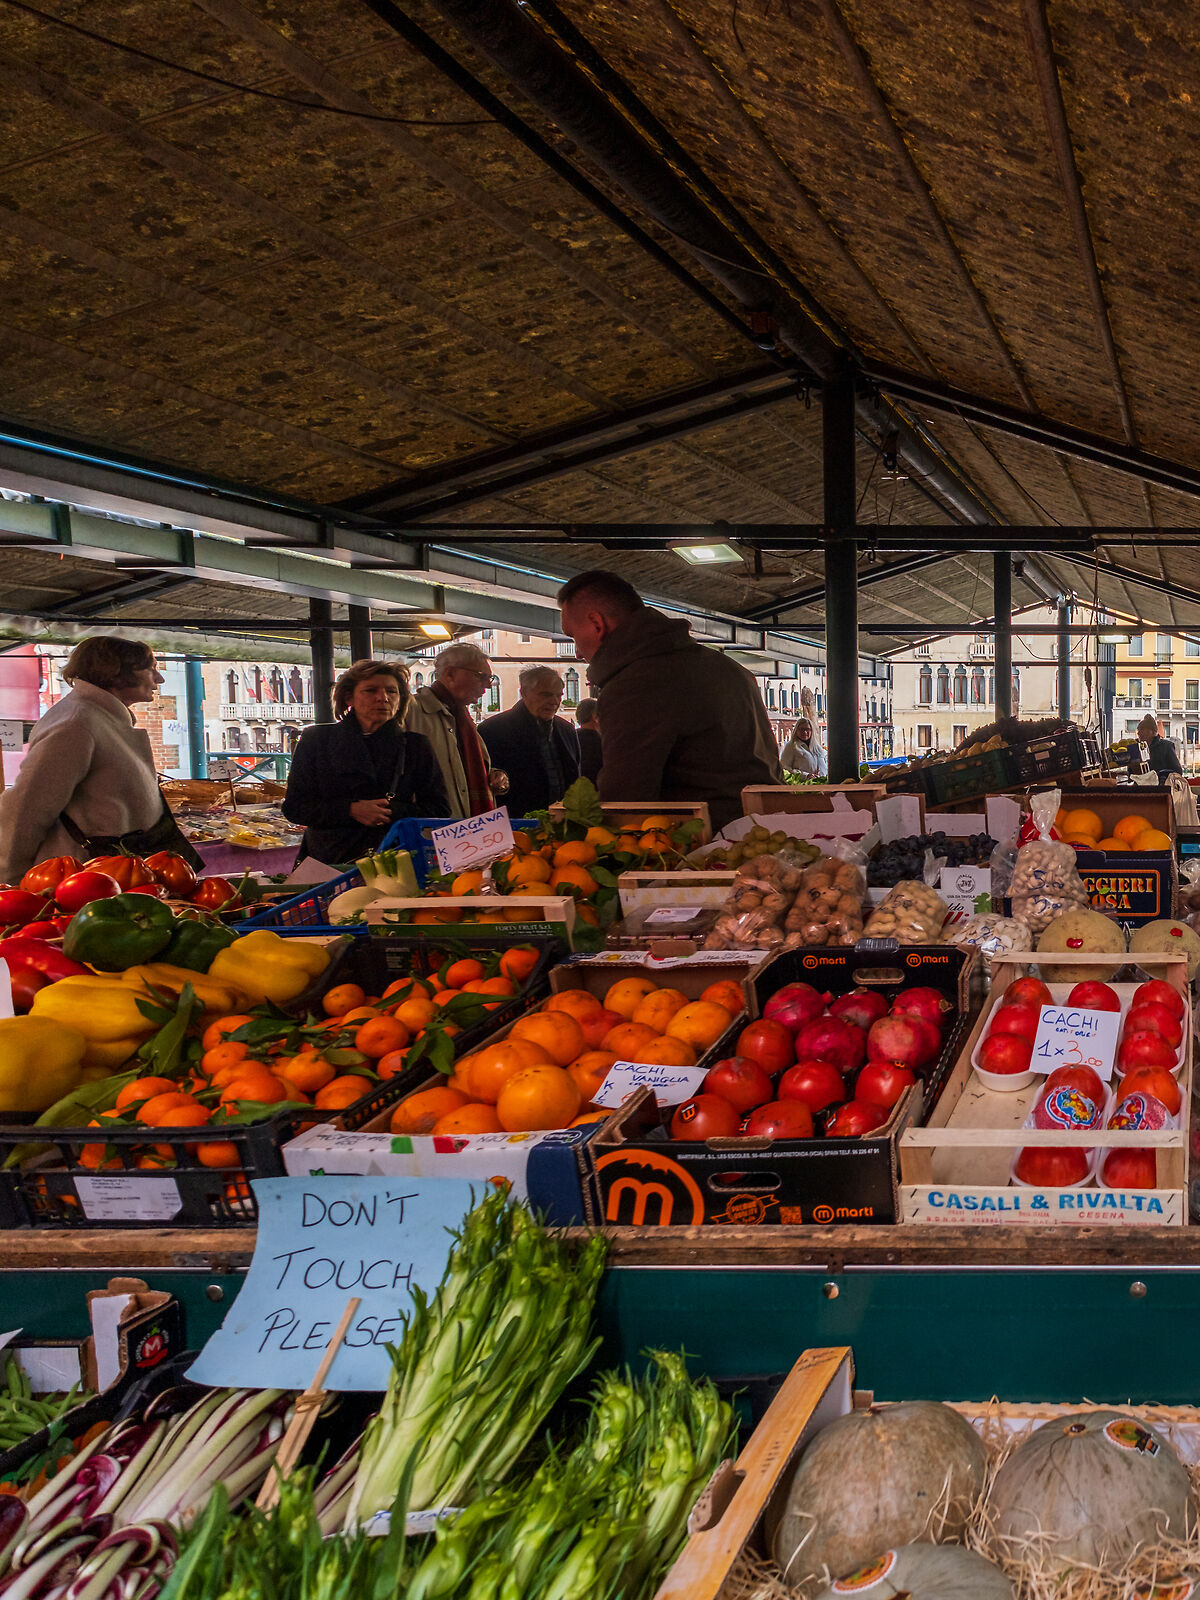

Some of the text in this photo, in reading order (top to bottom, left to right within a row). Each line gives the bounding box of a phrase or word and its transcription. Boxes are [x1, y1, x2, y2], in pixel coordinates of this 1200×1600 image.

[434, 811, 504, 841] MIYAGAWA
[454, 831, 504, 860] 3.50
[1084, 877, 1153, 893] GGIERI
[1088, 894, 1132, 909] OSA
[1042, 1010, 1099, 1031] CACHI
[614, 1063, 665, 1075] CACHI
[632, 1074, 690, 1083] VANIGLIA
[302, 1191, 420, 1227] DON'T
[928, 1190, 1164, 1214] CASALI & RIVALTA
[1078, 1211, 1125, 1219] CESENA
[272, 1247, 414, 1290] TOUCH
[258, 1307, 406, 1353] PLESE
